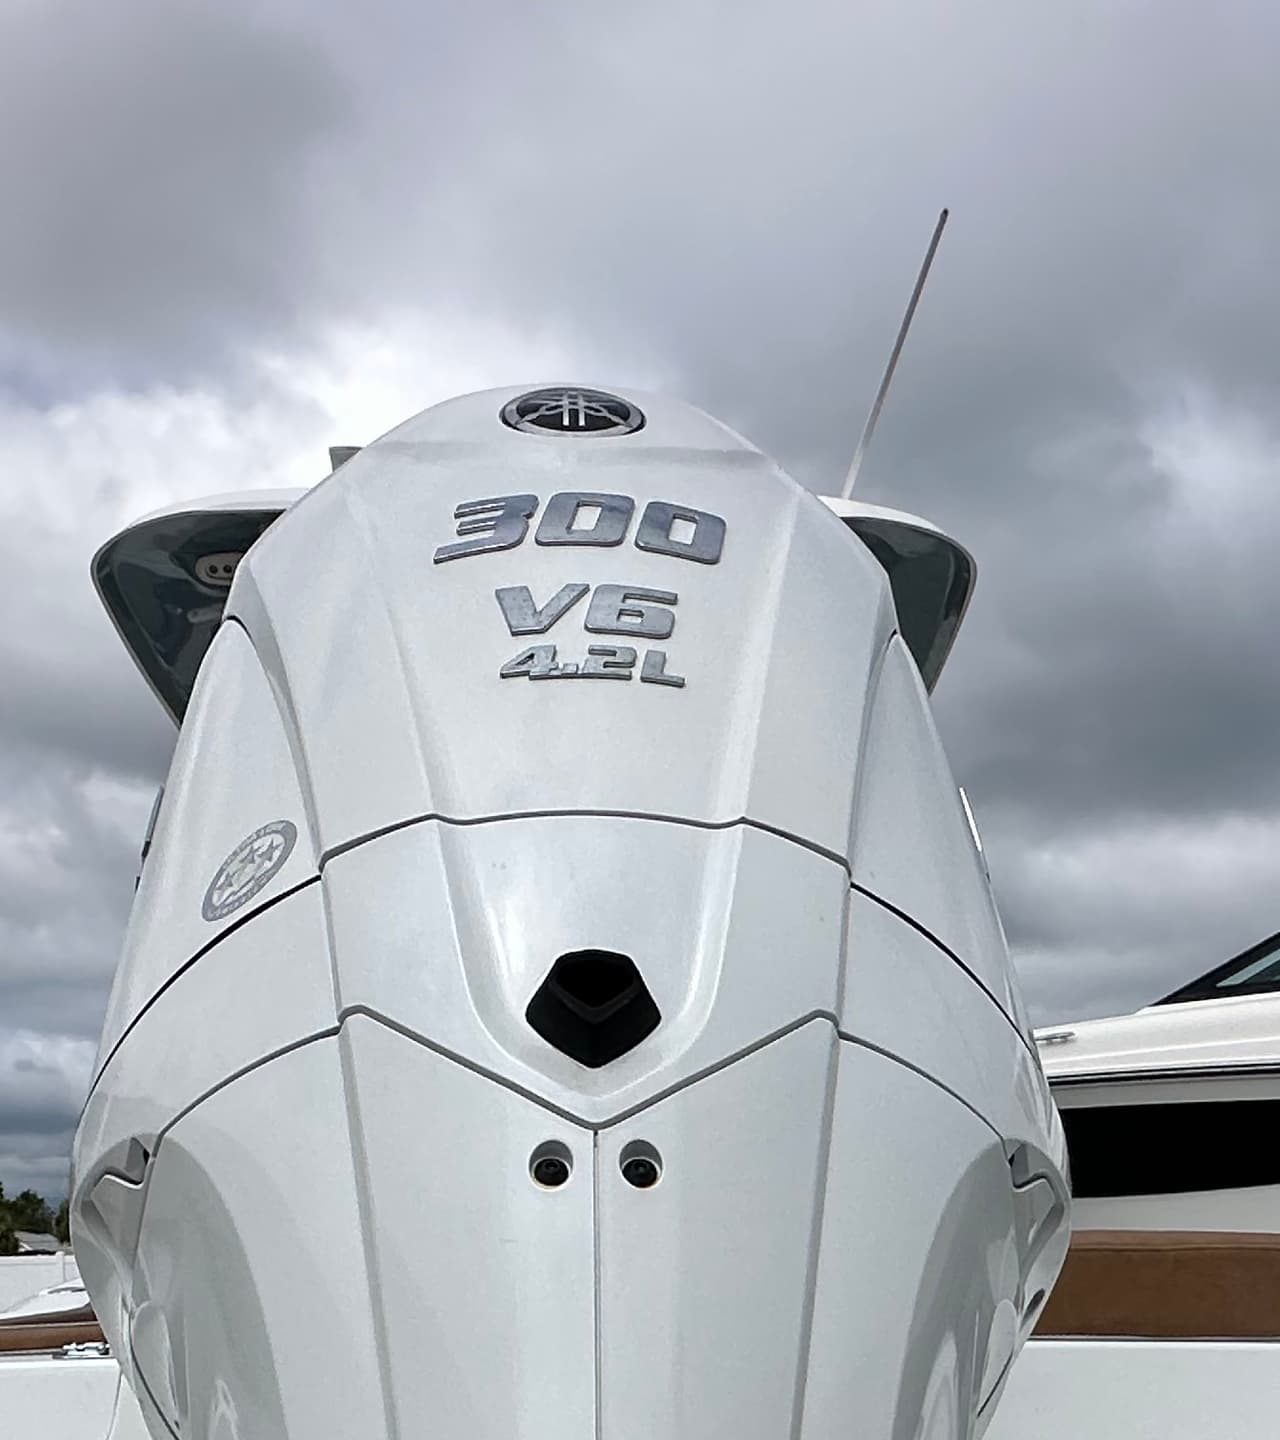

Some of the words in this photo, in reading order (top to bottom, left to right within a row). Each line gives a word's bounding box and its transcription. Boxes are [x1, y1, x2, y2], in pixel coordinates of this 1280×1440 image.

[433, 492, 727, 565] 300
[494, 583, 679, 640] V6
[499, 644, 686, 688] 4.2L
